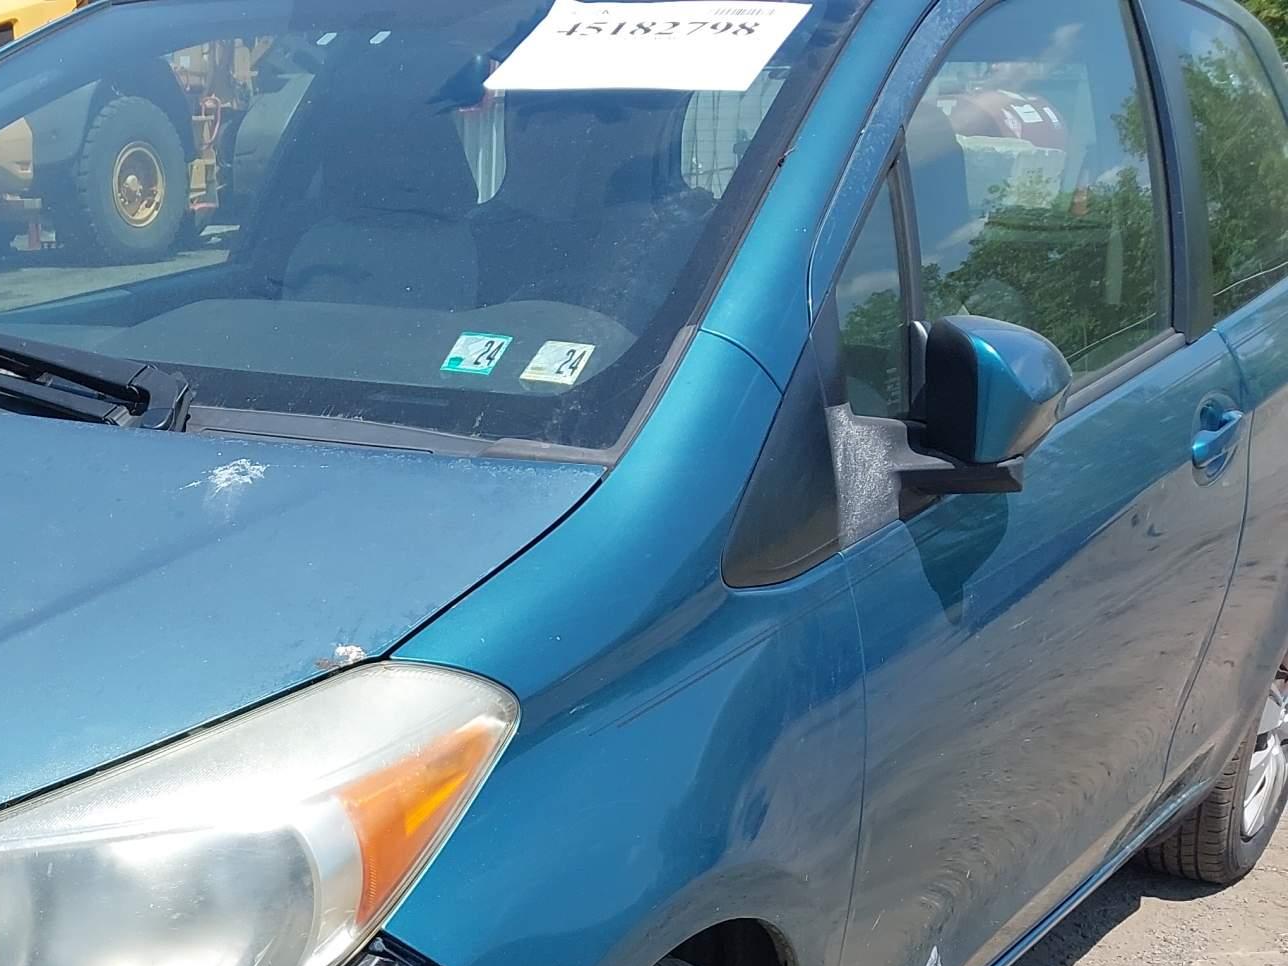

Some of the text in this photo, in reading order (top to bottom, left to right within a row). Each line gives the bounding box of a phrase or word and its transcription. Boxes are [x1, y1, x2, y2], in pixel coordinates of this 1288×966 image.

[557, 21, 760, 36] 45182798
[474, 340, 504, 366] 24
[556, 349, 587, 376] 24
